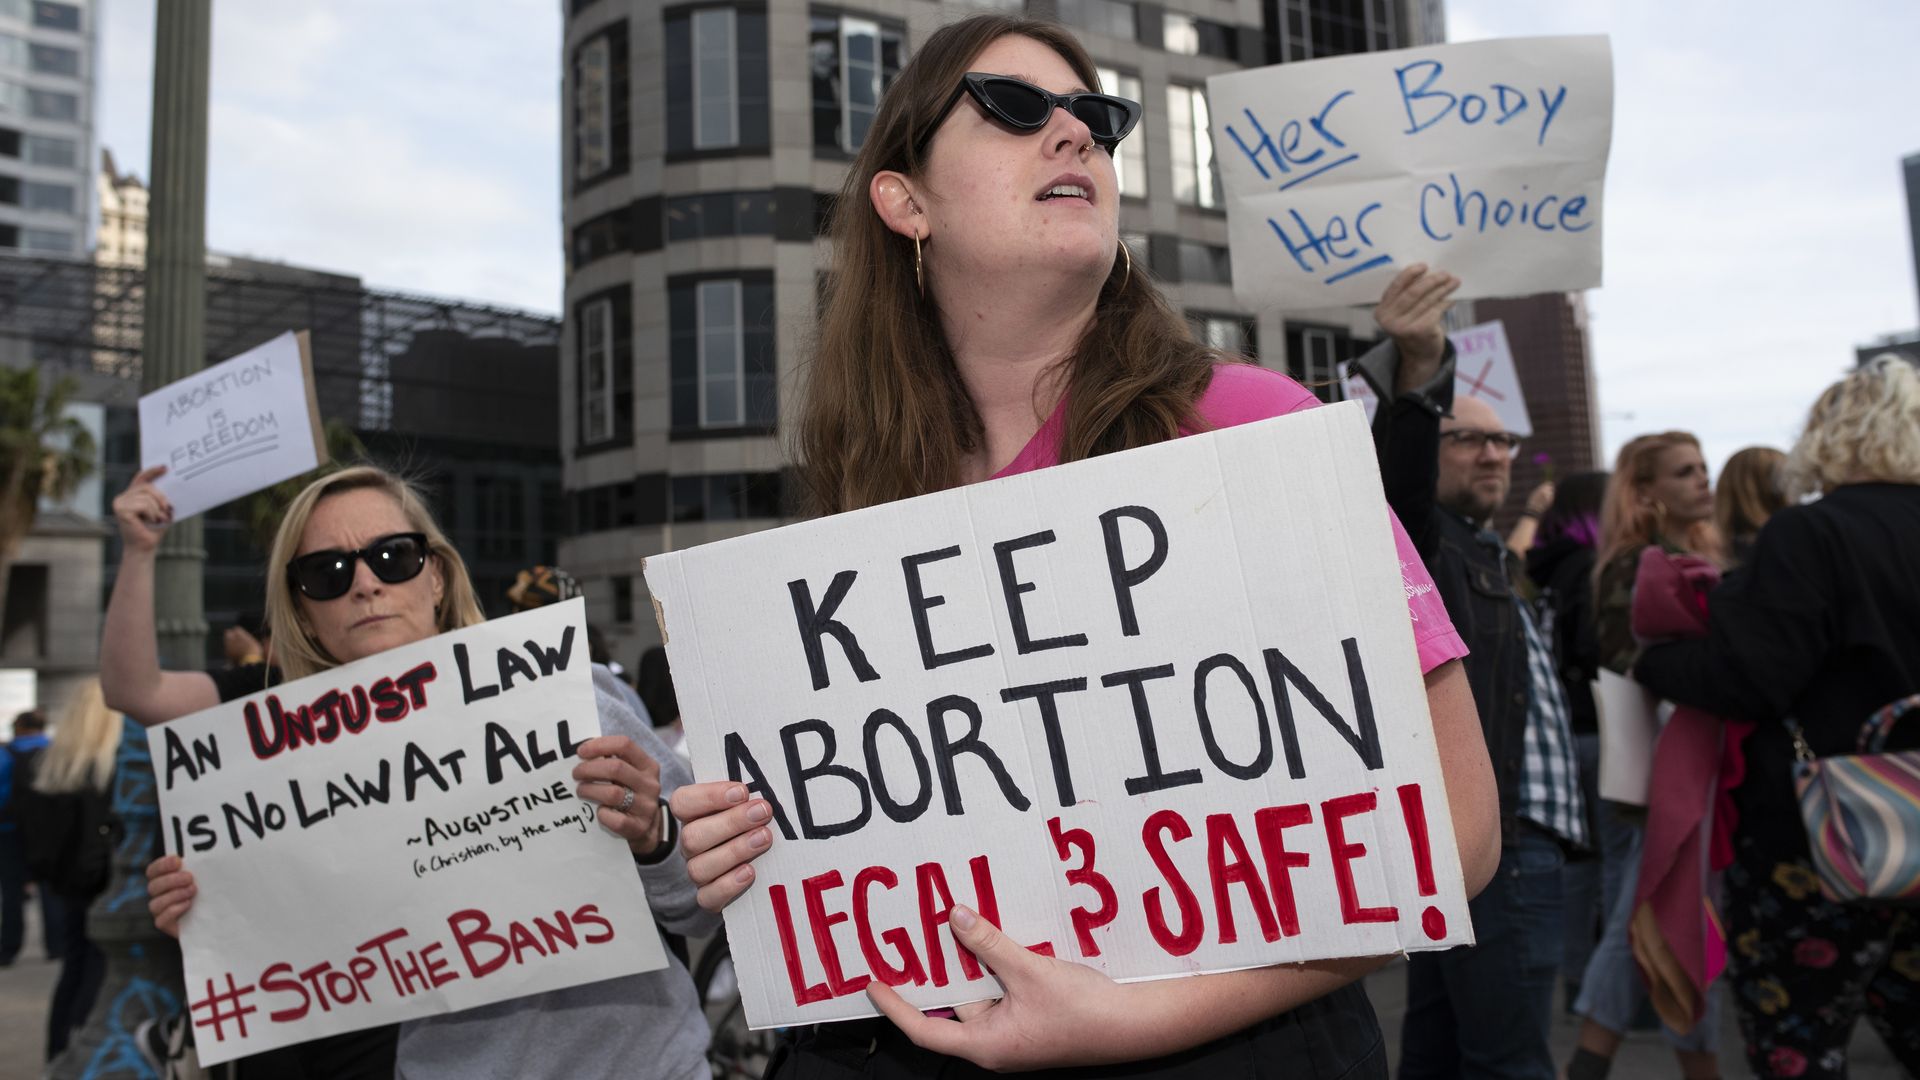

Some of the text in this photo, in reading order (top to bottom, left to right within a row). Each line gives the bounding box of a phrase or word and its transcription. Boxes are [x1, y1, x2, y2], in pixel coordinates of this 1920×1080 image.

[1226, 90, 1355, 179] Her
[1267, 173, 1593, 272] Her Choice
[165, 358, 273, 427] ABORTION
[170, 411, 279, 468] FREEDOM
[207, 408, 227, 429] IS
[787, 505, 1170, 690] KEEP
[165, 626, 575, 789] AN UNJUST LAW
[723, 637, 1385, 840] ABORTION
[172, 719, 594, 856] IS NO LAW AT ALL
[431, 842, 500, 872] Christian,
[499, 834, 523, 851] by
[523, 824, 550, 838] the
[769, 855, 1056, 1007] LEGAL
[1142, 783, 1448, 957] SAFE!
